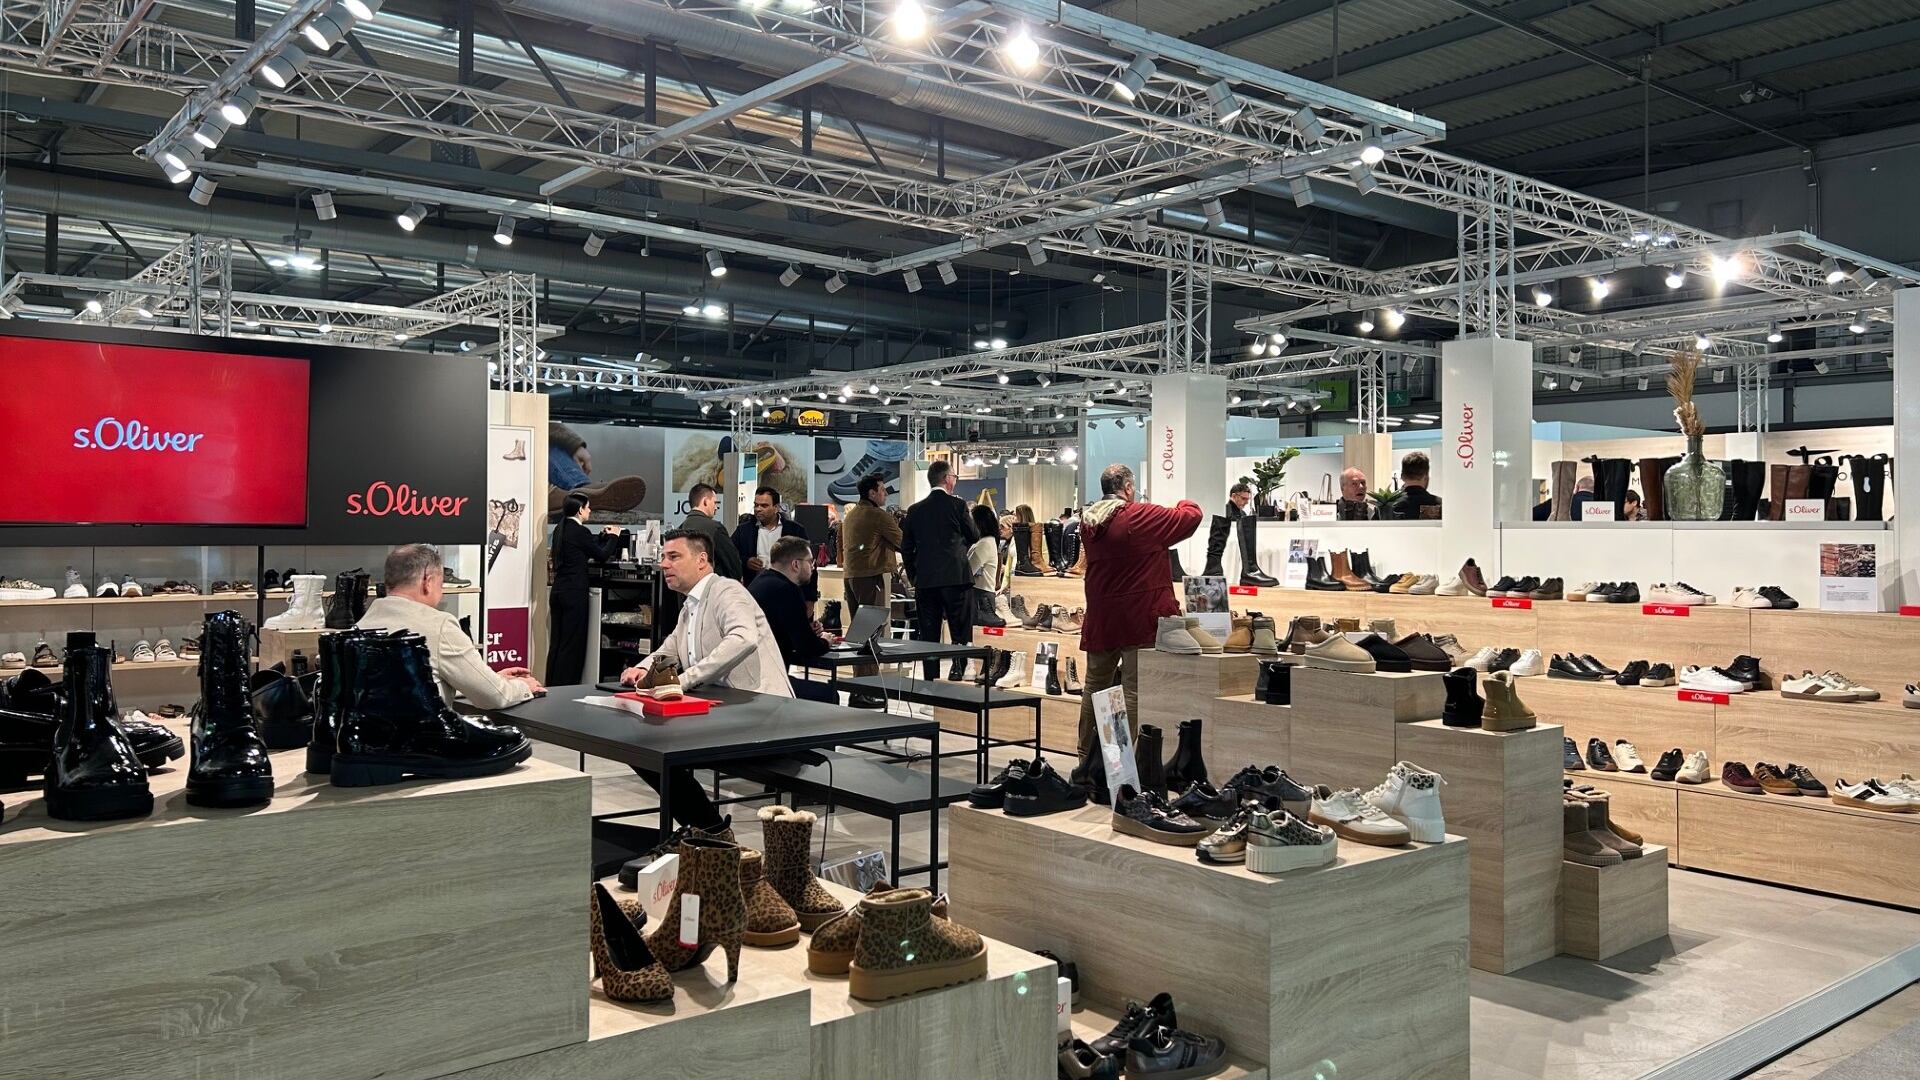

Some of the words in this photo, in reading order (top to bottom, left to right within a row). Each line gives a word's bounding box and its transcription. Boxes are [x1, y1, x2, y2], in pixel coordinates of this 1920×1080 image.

[73, 416, 204, 452] s.Oliver
[1457, 403, 1474, 469] s.Oliver
[1162, 425, 1174, 480] s.Oliver
[346, 481, 469, 516] s.Oliver
[1585, 506, 1611, 515] s.Oliver
[1789, 505, 1820, 514] s.Oliver
